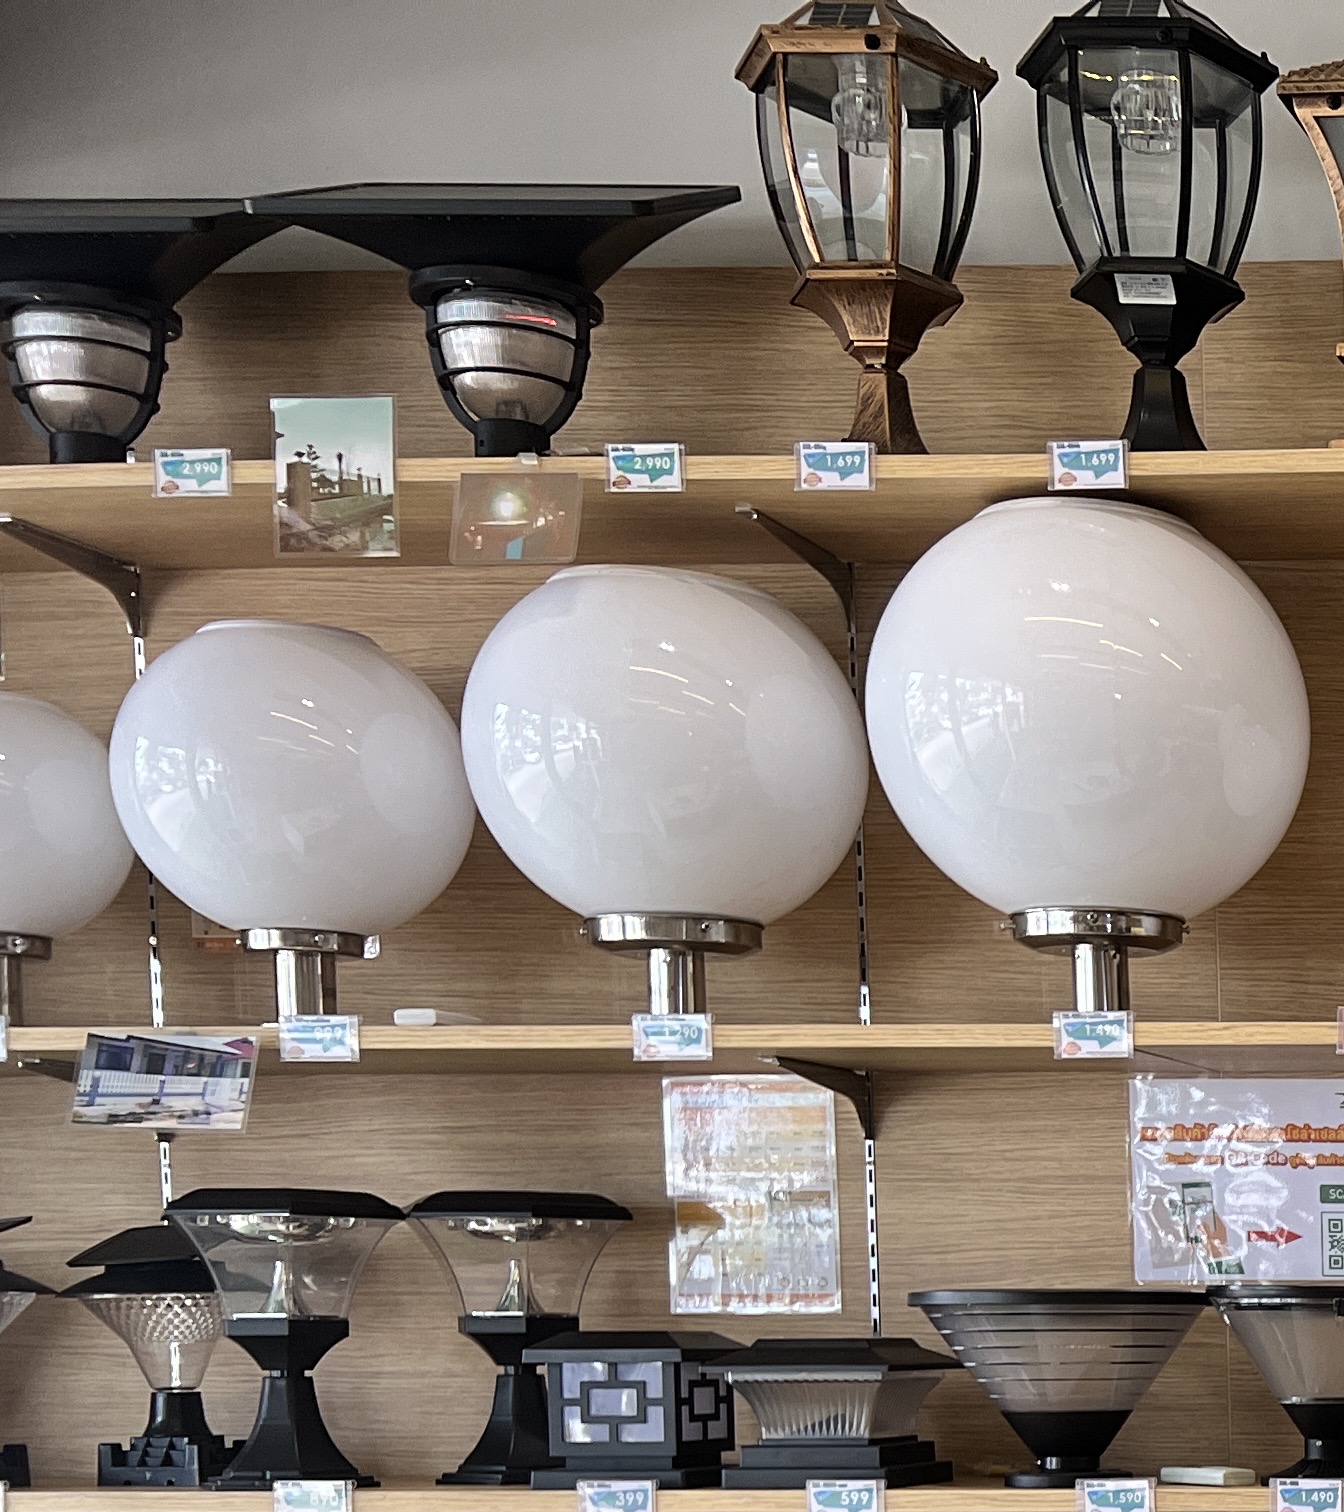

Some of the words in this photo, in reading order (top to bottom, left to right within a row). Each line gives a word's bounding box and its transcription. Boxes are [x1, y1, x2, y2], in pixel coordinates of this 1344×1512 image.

[633, 456, 670, 471] 2,990
[826, 454, 861, 469] 1,699
[1080, 453, 1115, 467] 1,699
[181, 462, 218, 476] 2,990
[615, 1491, 645, 1505] 399
[840, 1491, 869, 1505] 599
[1106, 1491, 1141, 1504] 1,590
[1300, 1491, 1334, 1504] 1,490
